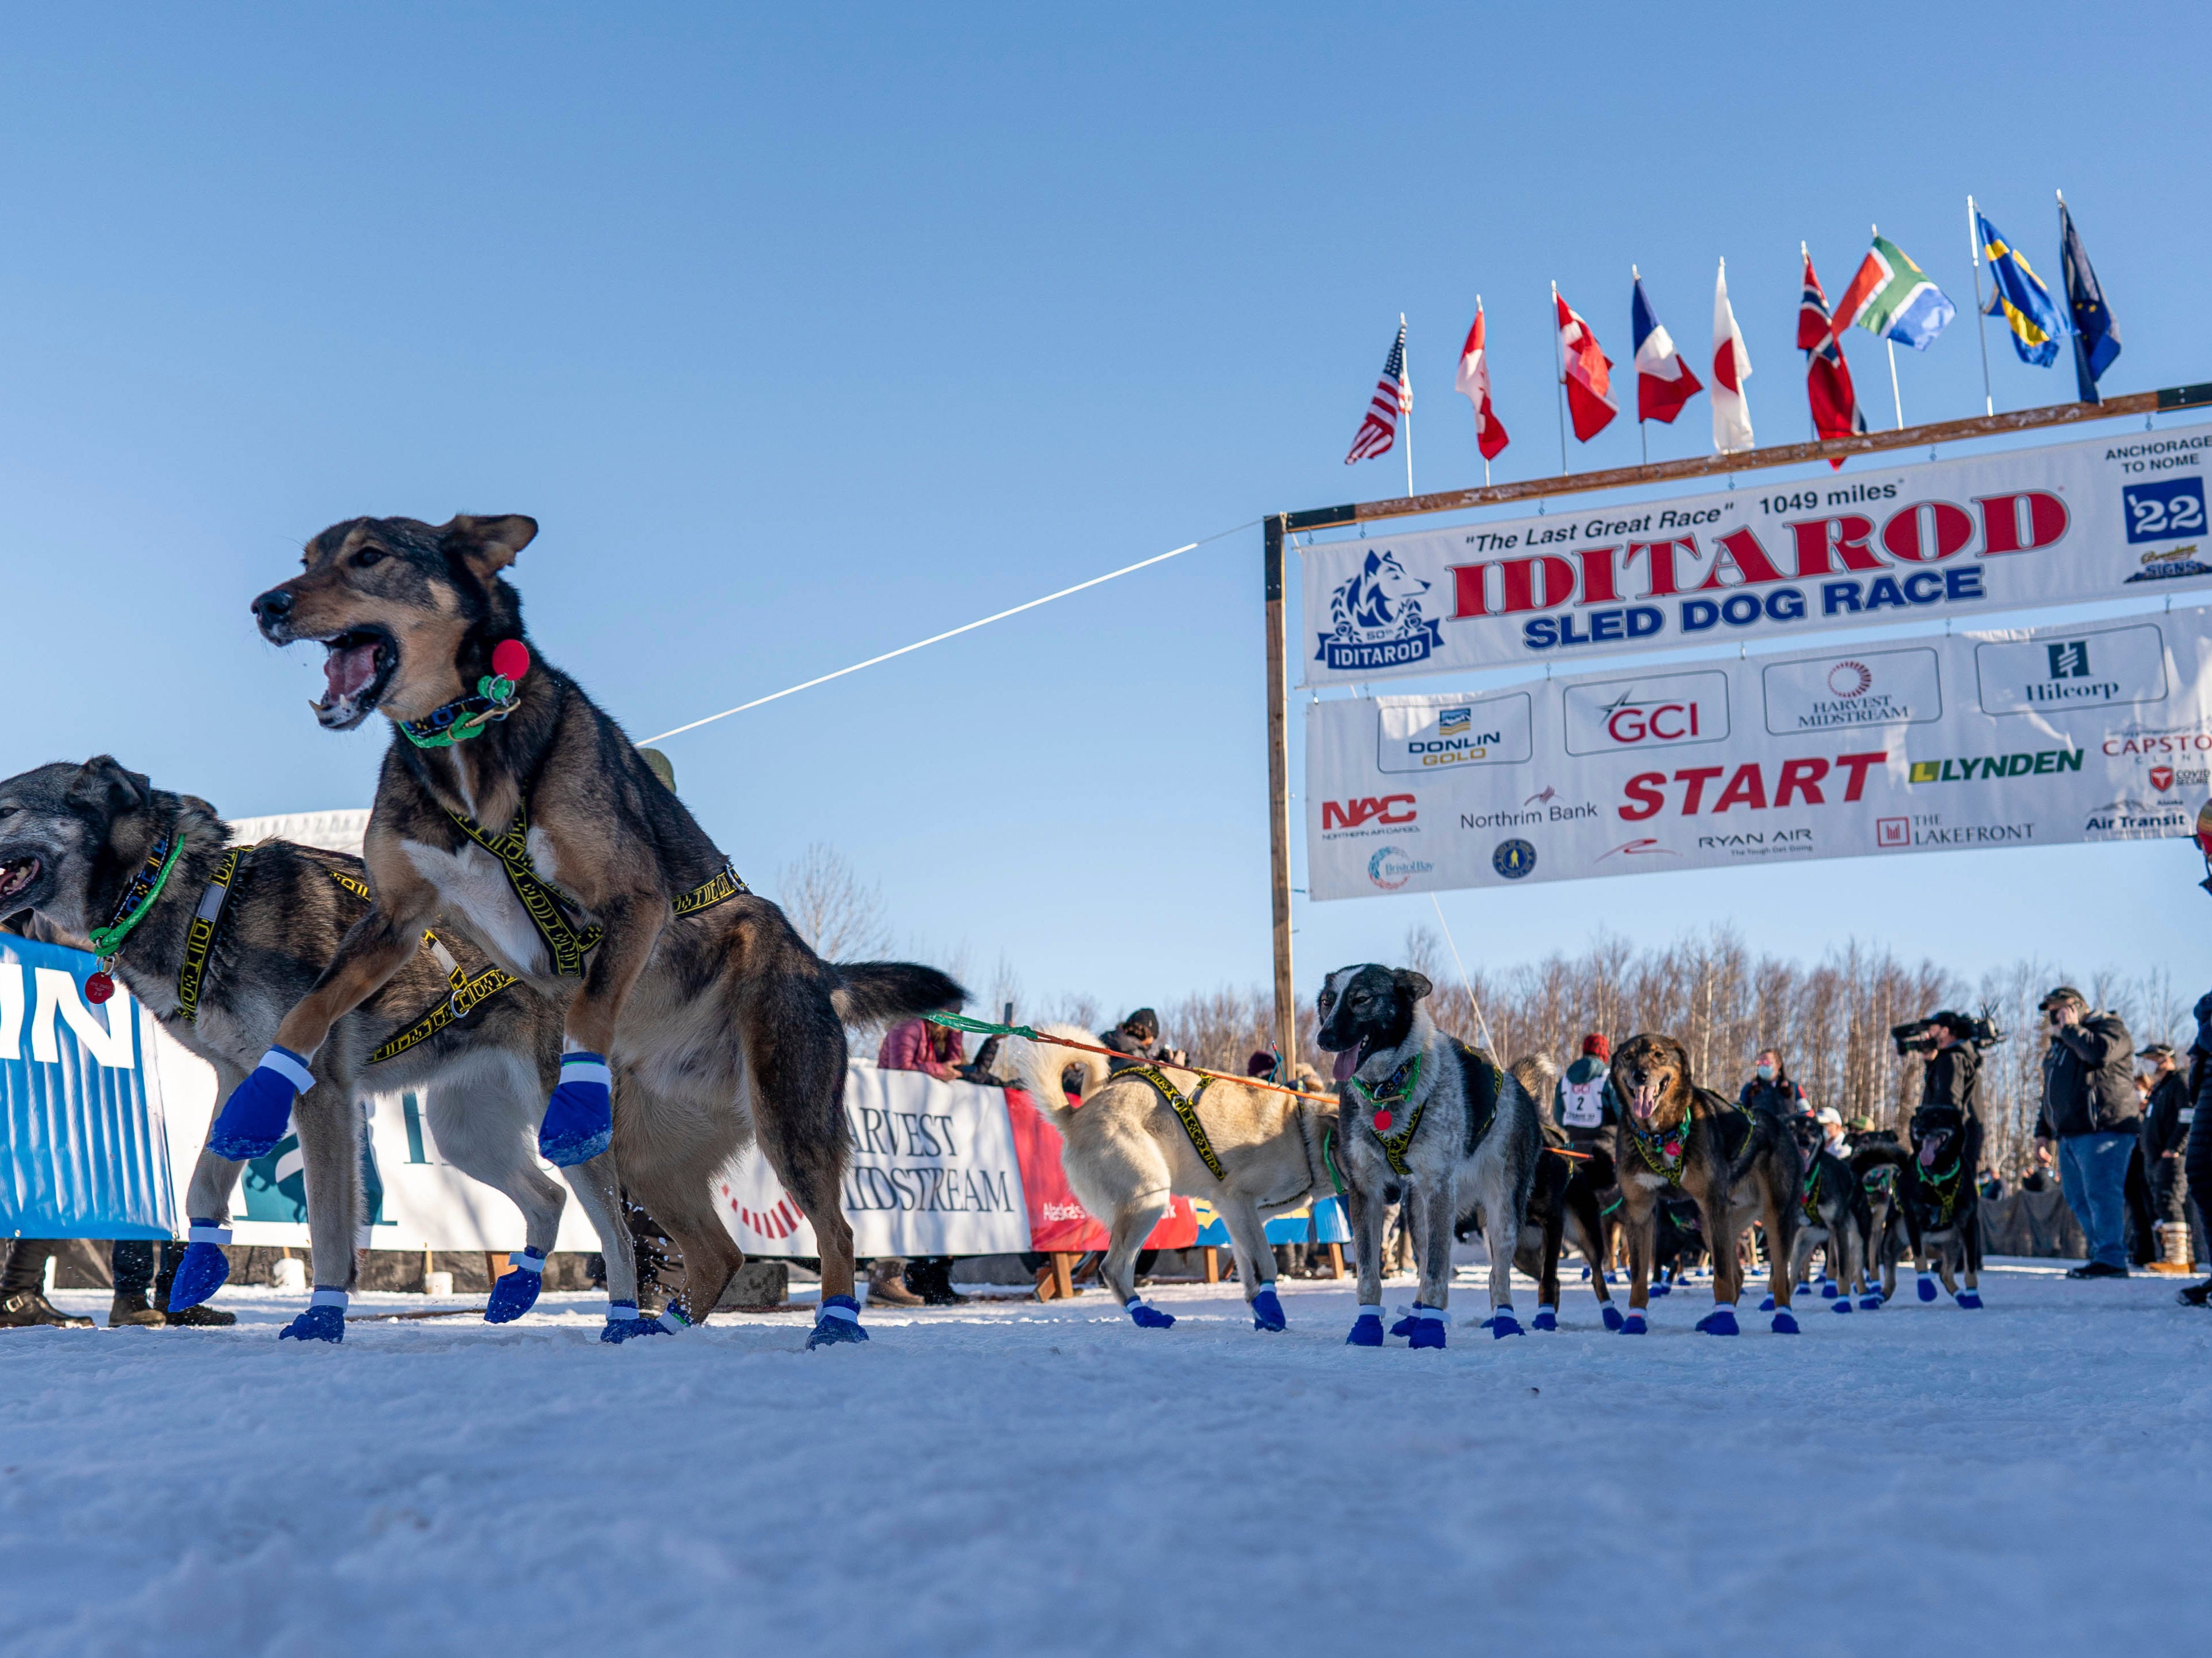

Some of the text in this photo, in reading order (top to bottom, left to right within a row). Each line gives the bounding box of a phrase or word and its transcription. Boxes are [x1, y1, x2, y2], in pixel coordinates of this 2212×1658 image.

[2105, 435, 2212, 461] ANCHORAGE
[2122, 453, 2201, 474] TO NOME
[1466, 533, 1518, 552] "The
[1526, 524, 1578, 545] Last
[1585, 515, 1651, 539] Great
[1659, 502, 1734, 529] Race"
[1760, 492, 1818, 514] 1049
[1446, 489, 2071, 622] IDITAROD
[1523, 564, 1985, 651] SLED DOG RACE
[1334, 640, 1423, 667] IDITAROD
[1812, 694, 1892, 713] HARVEST
[2025, 681, 2119, 703] Hilcorp
[1608, 702, 1698, 743] GCI
[1798, 706, 1908, 728] MIDSTREAM
[1408, 732, 1500, 754] DONLIN
[1422, 748, 1487, 766] GOLD
[1941, 749, 2084, 781] LYNDEN
[2176, 768, 2210, 778] COVID
[1618, 751, 1888, 822] START
[1322, 793, 1417, 829] NAC
[1460, 801, 1598, 829] Northrim Bank
[1914, 814, 1942, 826] THE
[2086, 813, 2185, 830] Air Transit
[1699, 829, 1812, 849] RYAN AIR
[1915, 822, 2036, 846] LAKEFRONT
[1577, 1096, 1584, 1110] 2
[847, 1107, 957, 1157] ARVEST
[845, 1166, 1015, 1212] IDSTREAM
